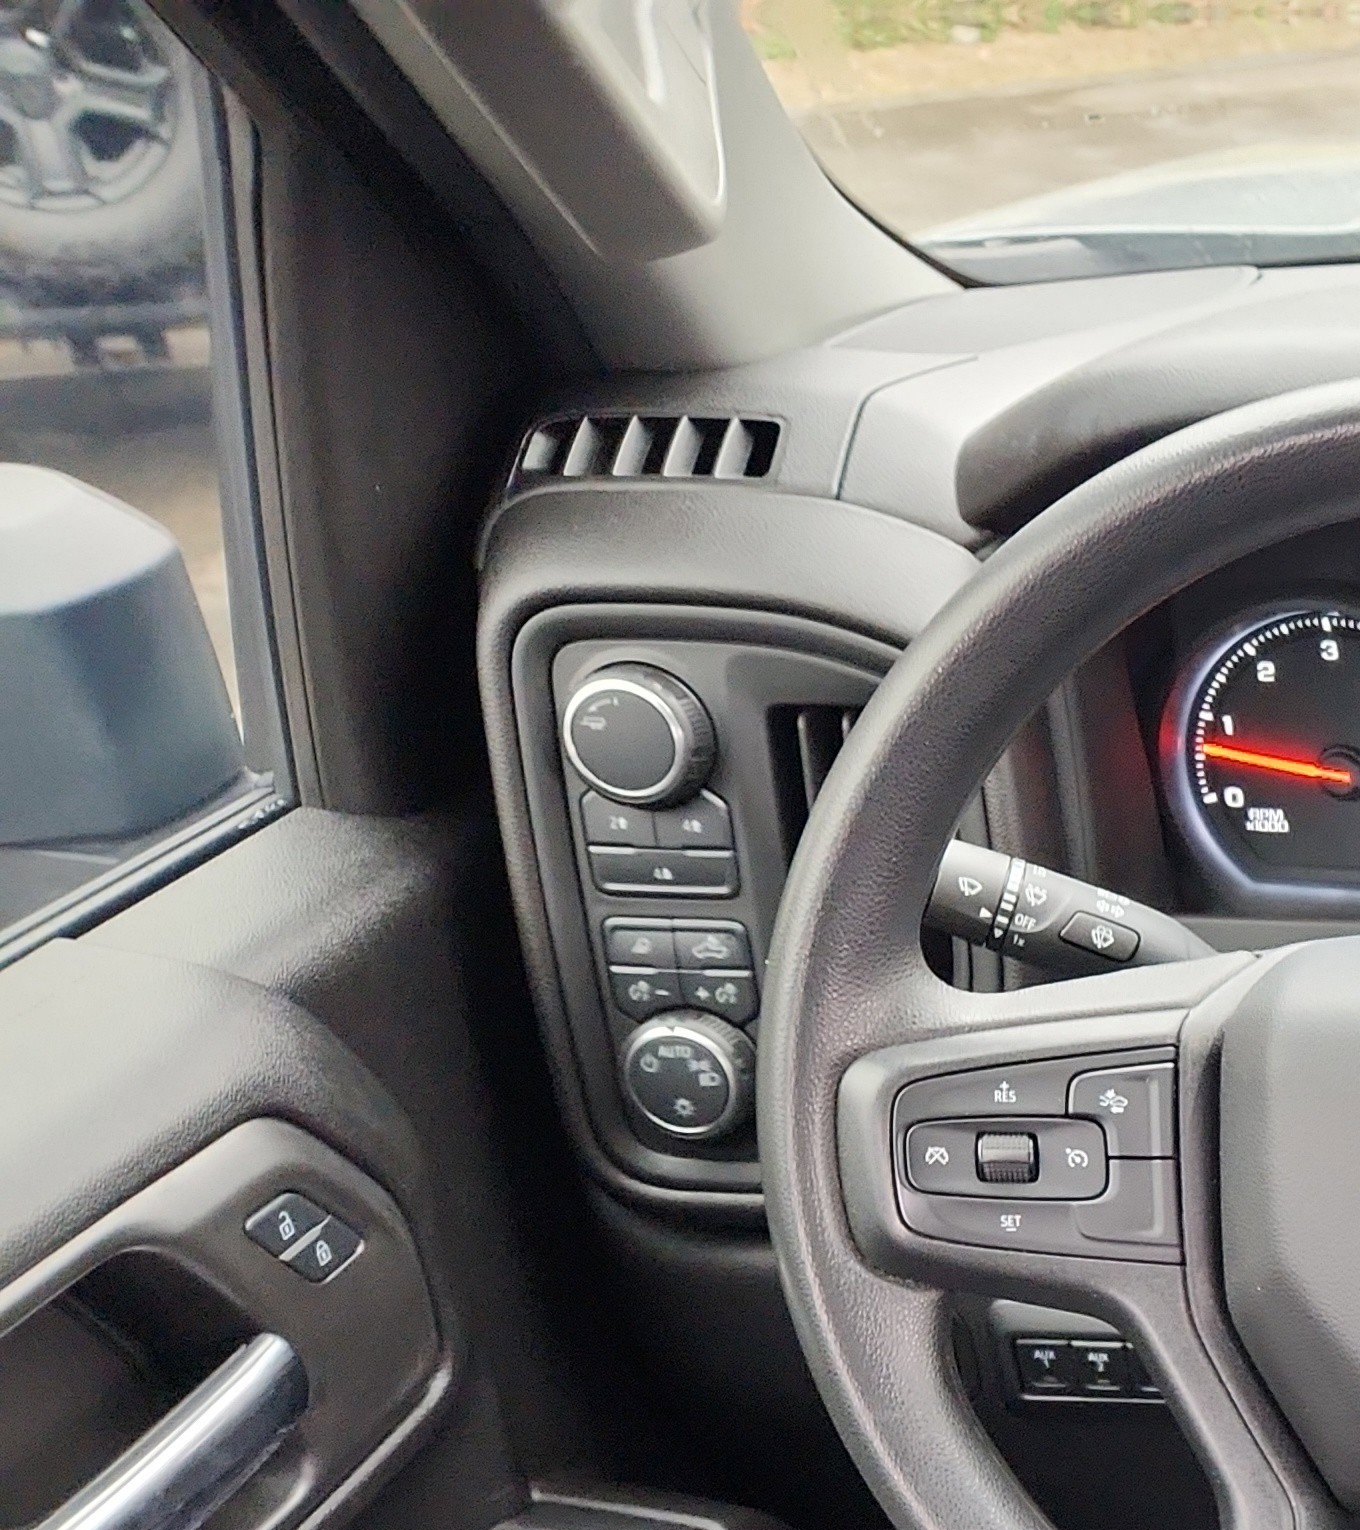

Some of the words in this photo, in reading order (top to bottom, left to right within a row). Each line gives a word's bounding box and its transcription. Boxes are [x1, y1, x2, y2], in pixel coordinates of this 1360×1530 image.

[1320, 639, 1340, 662] 3
[1256, 660, 1276, 683] 2
[1222, 714, 1234, 736] 1
[1224, 786, 1245, 808] 0
[1247, 807, 1284, 821] RPM
[1014, 912, 1037, 932] OFF
[994, 1088, 1017, 1104] RES
[1000, 1214, 1022, 1228] SET
